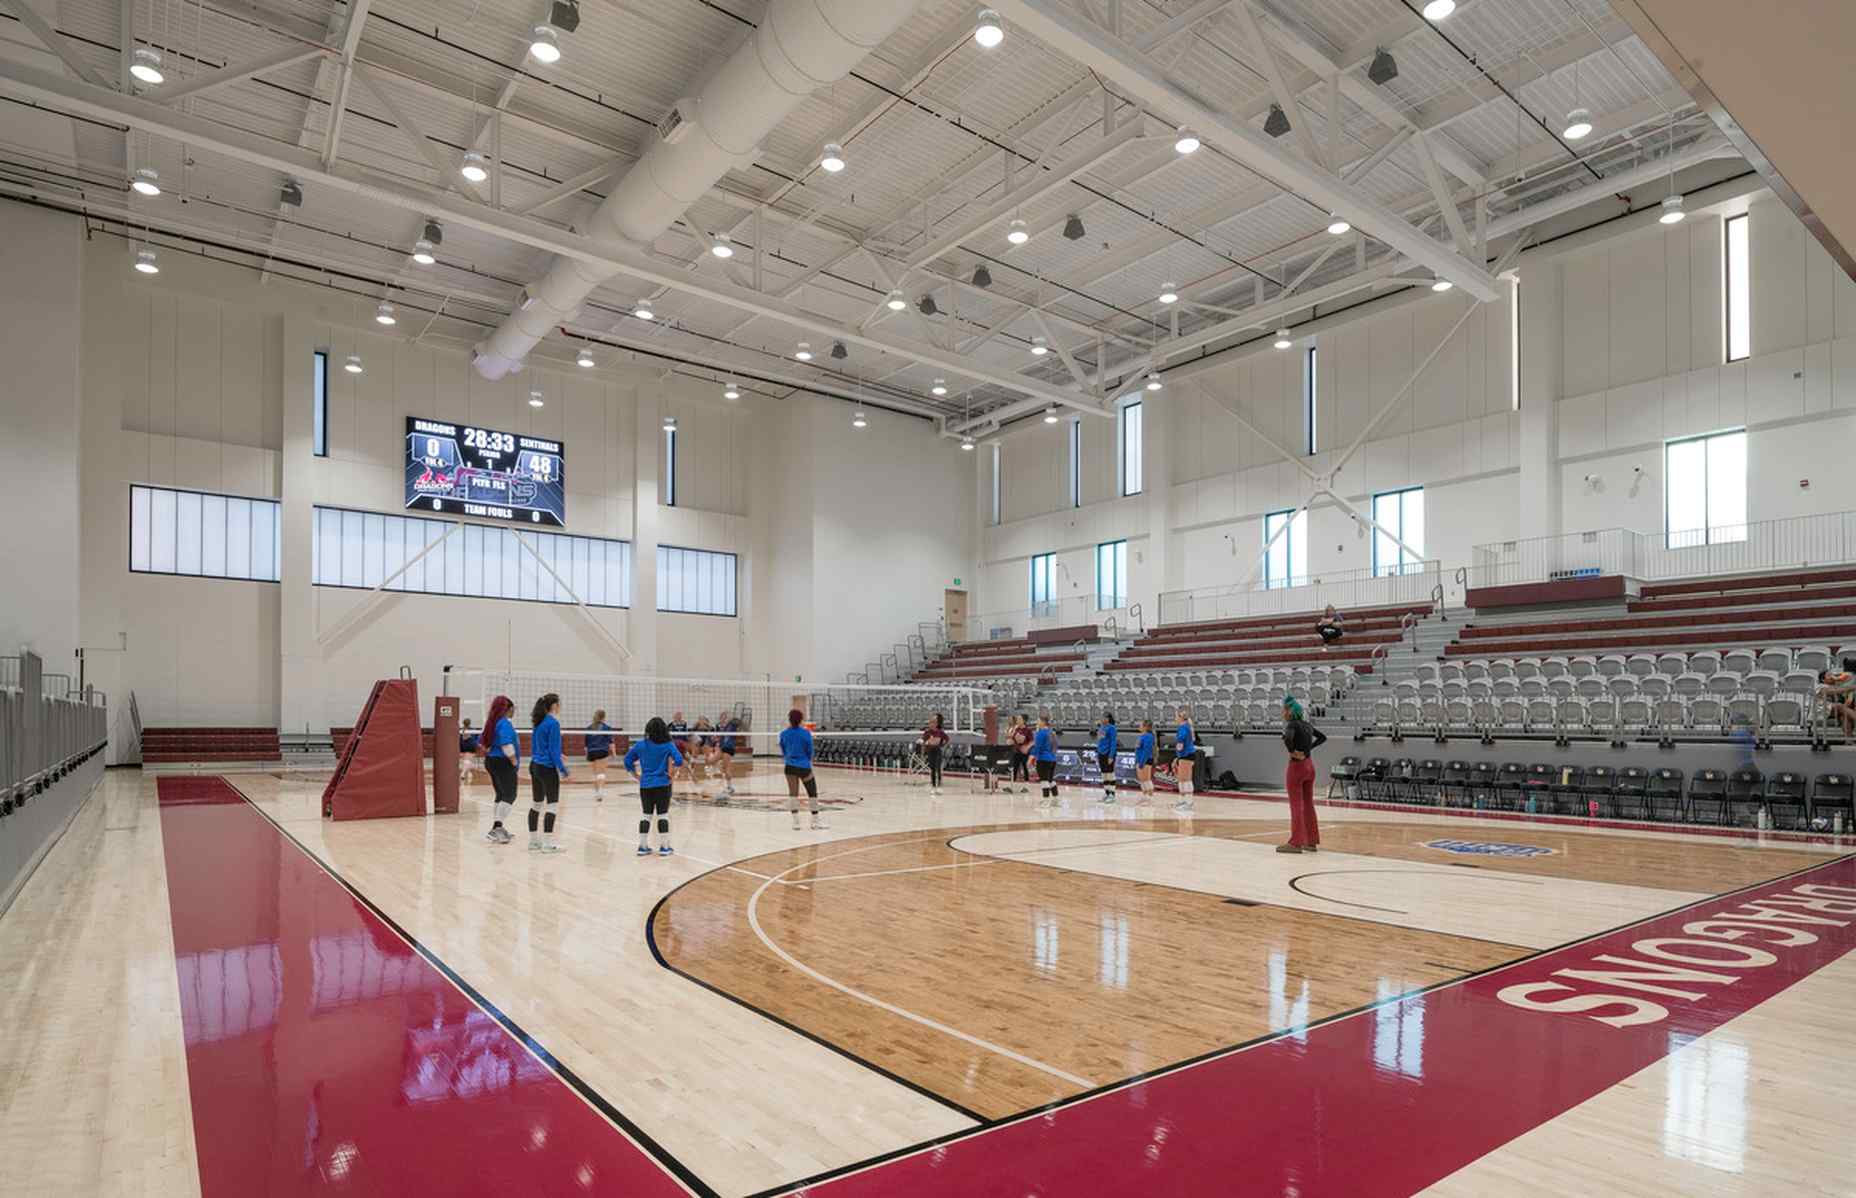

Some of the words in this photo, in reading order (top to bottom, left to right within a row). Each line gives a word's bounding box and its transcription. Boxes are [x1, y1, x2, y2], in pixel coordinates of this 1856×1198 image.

[415, 420, 456, 436] DRAGONS
[427, 438, 440, 457] 0
[464, 428, 514, 453] 28:33
[486, 459, 492, 469] 1
[529, 456, 551, 473] 48
[433, 499, 442, 510] 0
[464, 504, 487, 515] TEAM
[488, 506, 513, 518] FOULS
[532, 511, 540, 522] 0
